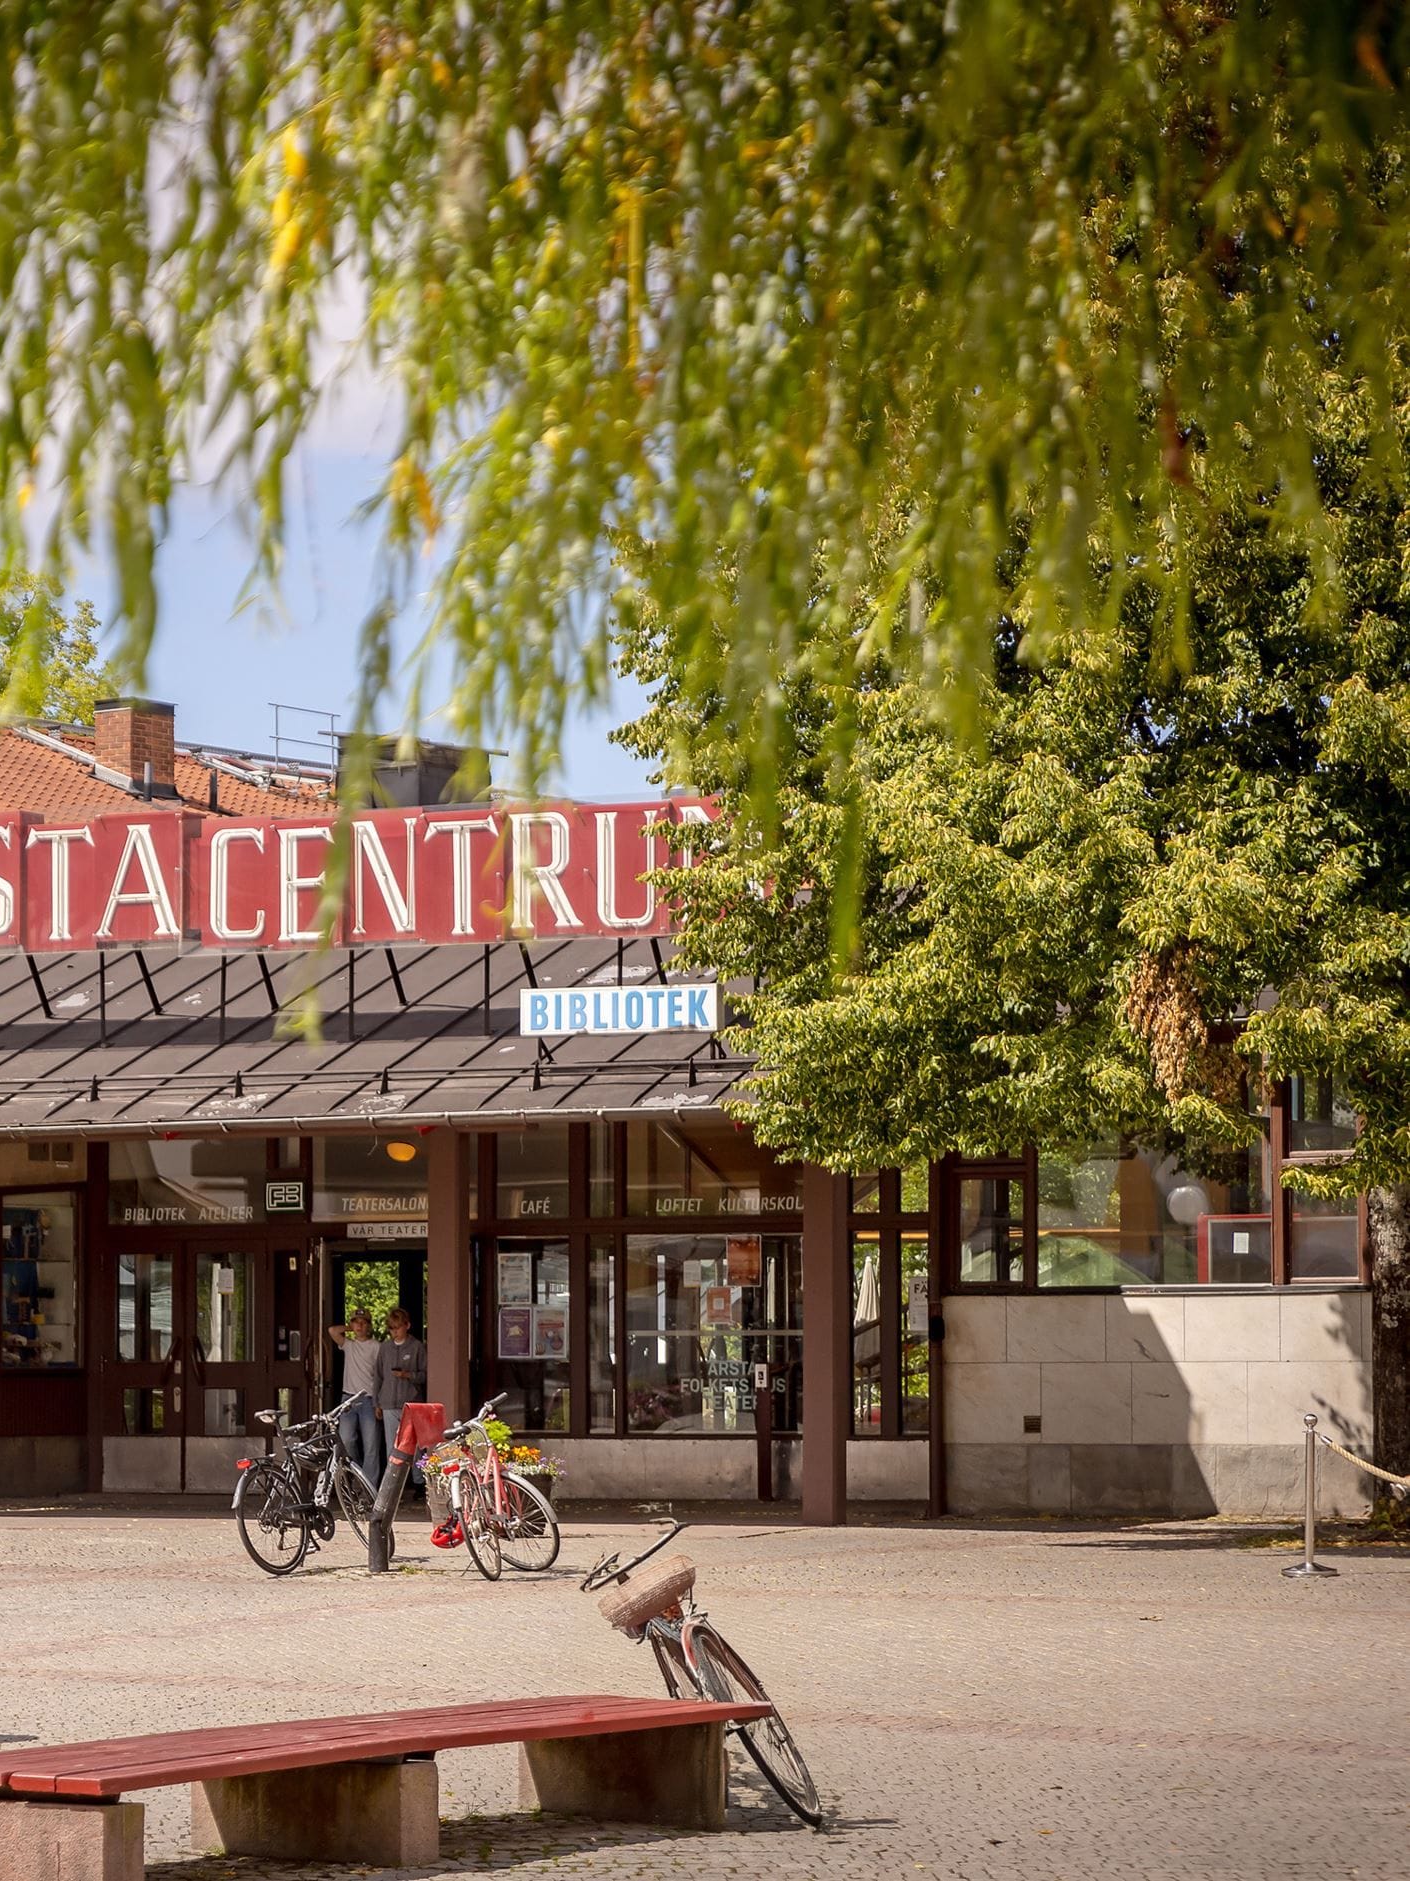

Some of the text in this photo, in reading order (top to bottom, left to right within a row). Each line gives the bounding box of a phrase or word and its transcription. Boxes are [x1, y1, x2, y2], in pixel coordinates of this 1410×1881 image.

[210, 806, 765, 942] CENTRU
[530, 989, 709, 1031] BIBLIOTEK
[342, 1197, 428, 1212] TEATERSALON
[521, 1197, 550, 1214] CAFÉ
[656, 1198, 703, 1213] LOFTET
[124, 1207, 186, 1221] BIBLIOTEK
[381, 1224, 427, 1235] TEATER
[680, 1378, 786, 1393] FOLKETS US
